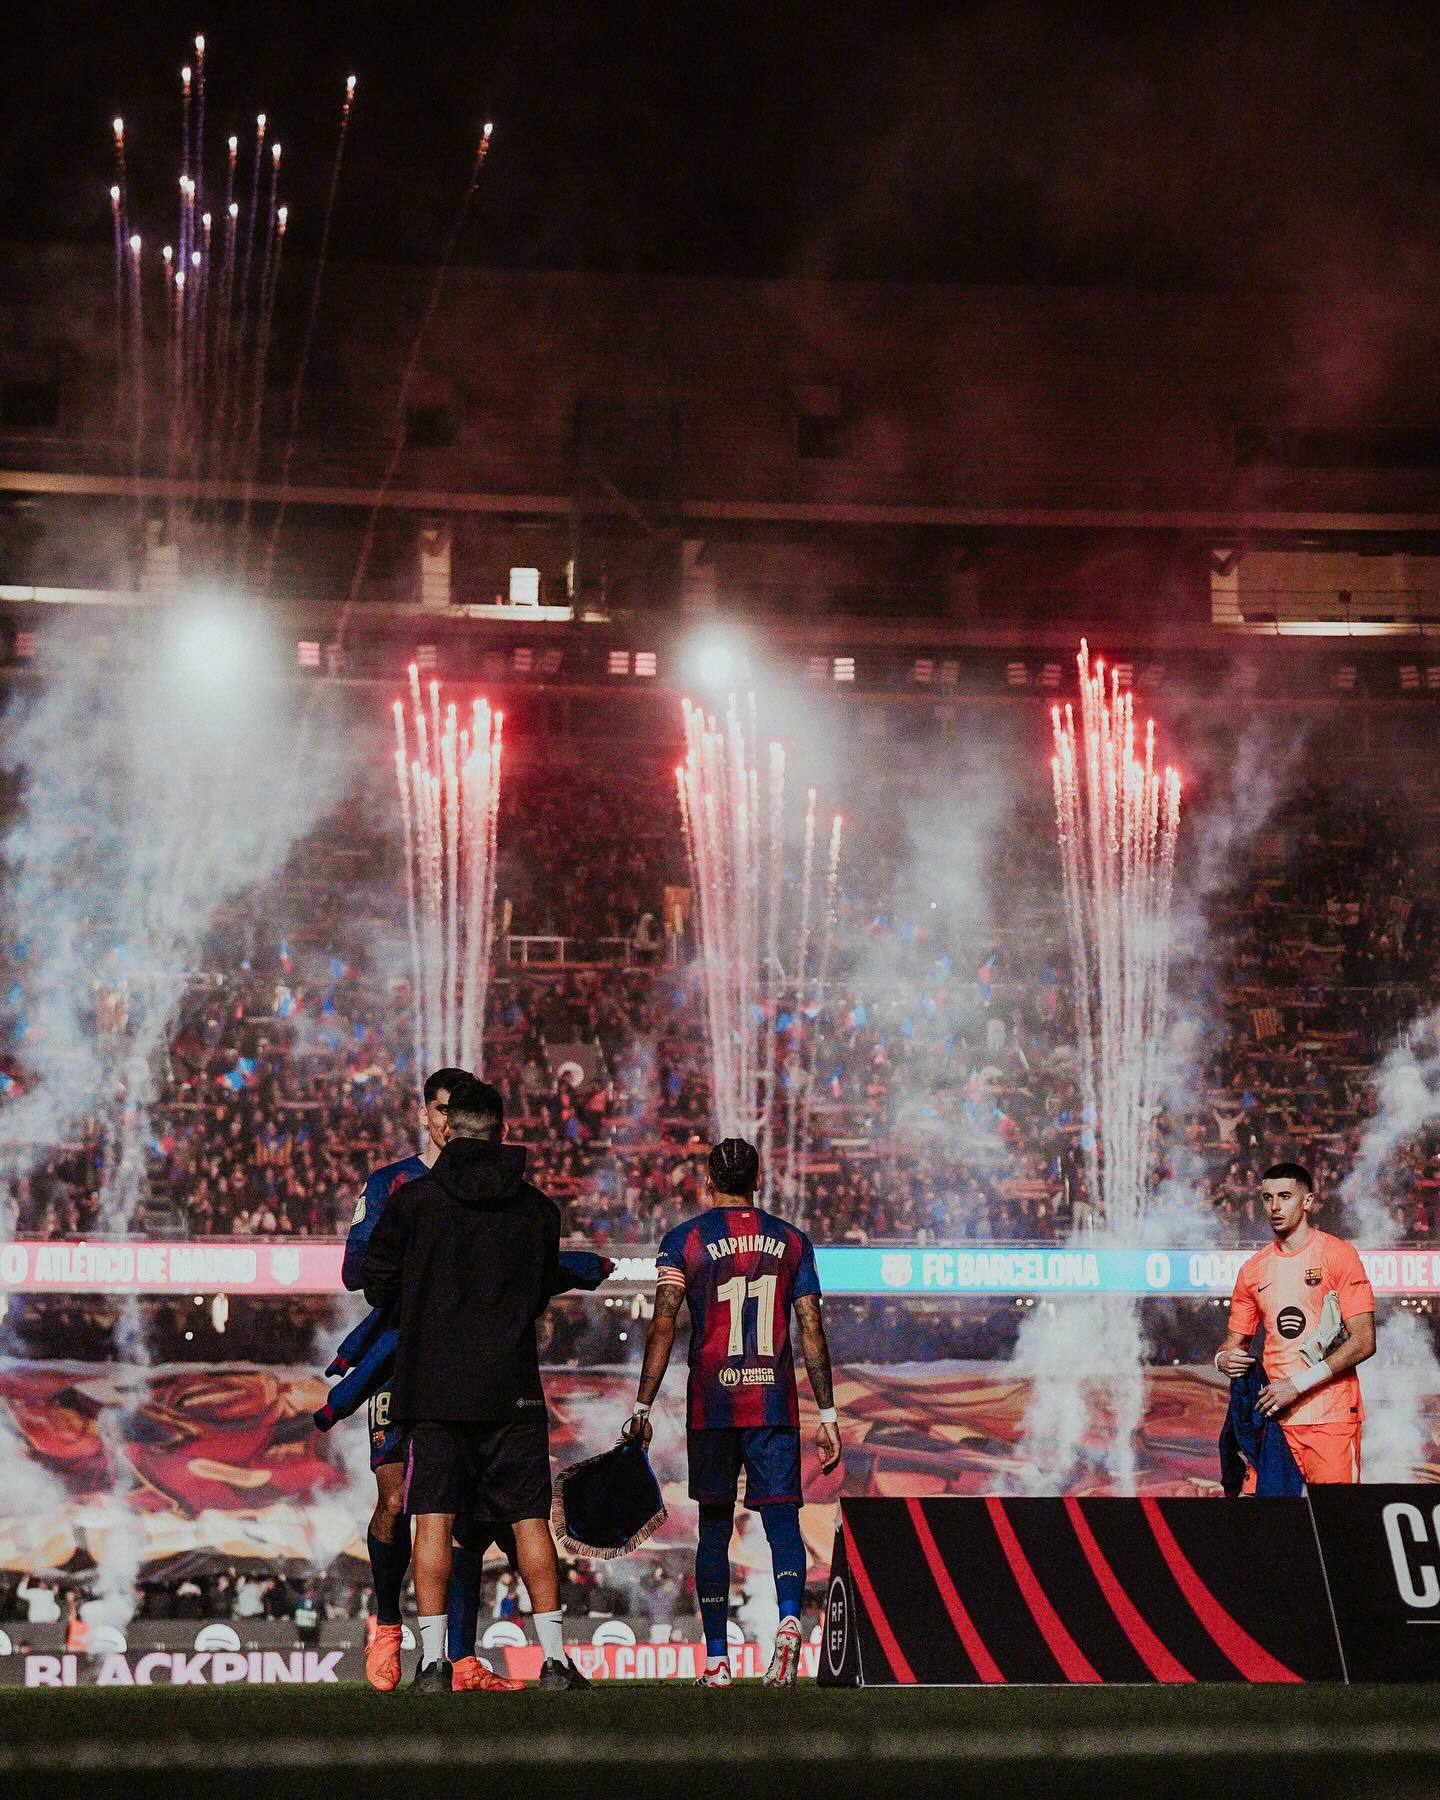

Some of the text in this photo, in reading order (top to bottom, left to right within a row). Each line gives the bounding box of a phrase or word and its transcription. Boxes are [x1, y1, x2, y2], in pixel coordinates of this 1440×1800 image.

[706, 1234, 786, 1261] RAPHINHA
[138, 1248, 168, 1283] DE
[923, 1254, 953, 1286] FC
[957, 1254, 1100, 1286] BARCELONA
[1401, 1255, 1428, 1286] DE
[717, 1274, 777, 1357] 11
[370, 1392, 391, 1429] 18
[1382, 1502, 1440, 1608] C
[831, 1602, 843, 1622] RF
[831, 1630, 843, 1651] EF
[615, 1646, 697, 1679] COPA
